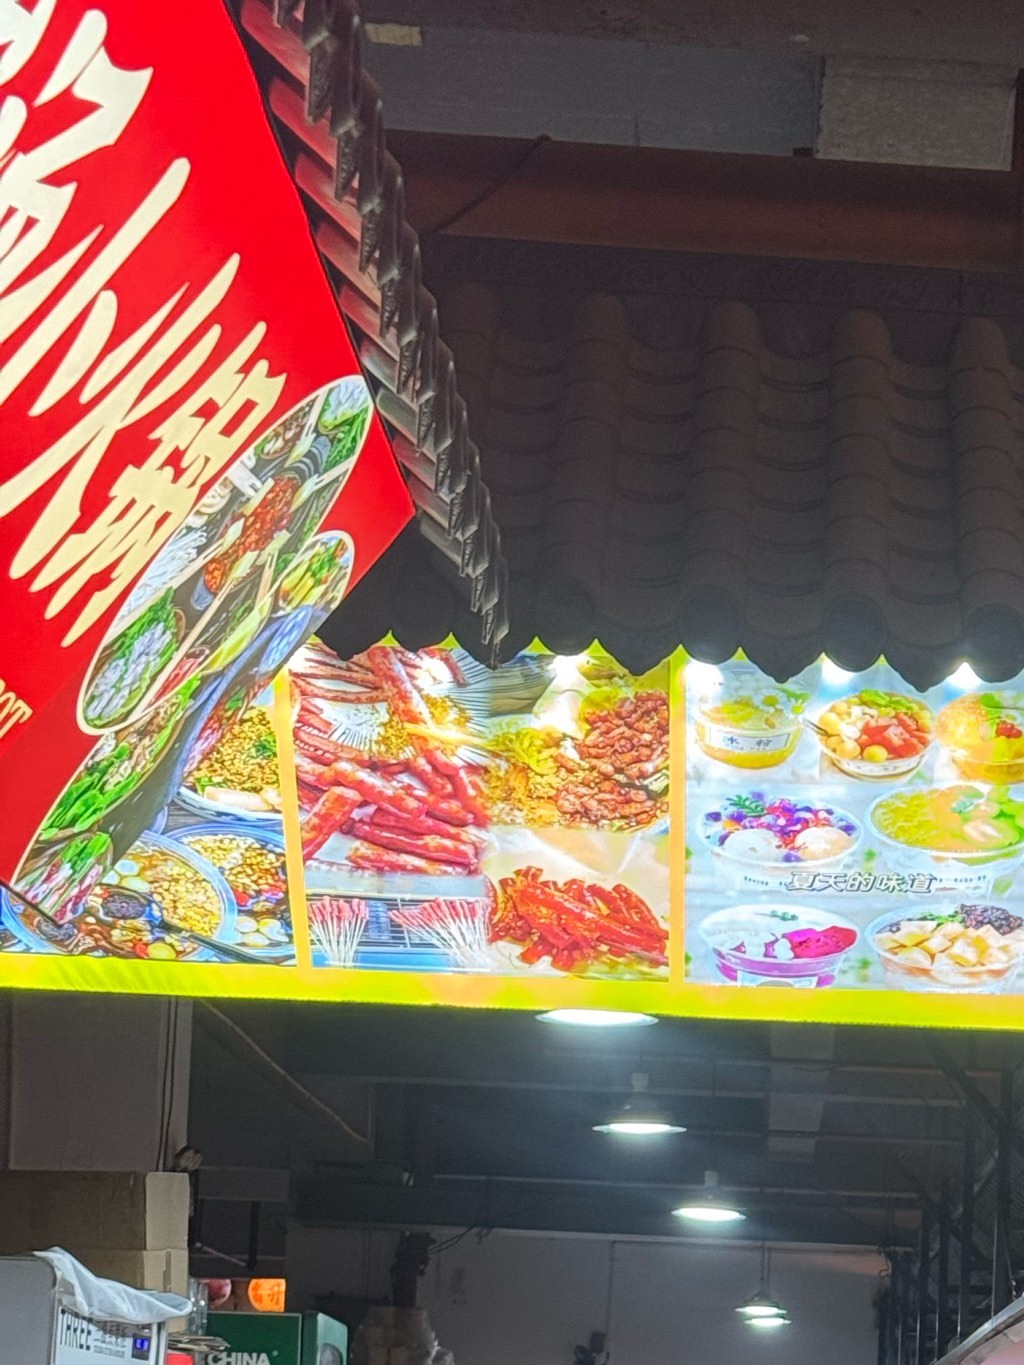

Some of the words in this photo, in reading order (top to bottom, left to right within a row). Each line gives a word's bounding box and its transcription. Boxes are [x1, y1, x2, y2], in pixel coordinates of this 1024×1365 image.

[0, 0, 287, 648] 汤小火锅
[787, 871, 936, 893] 夏天的味道
